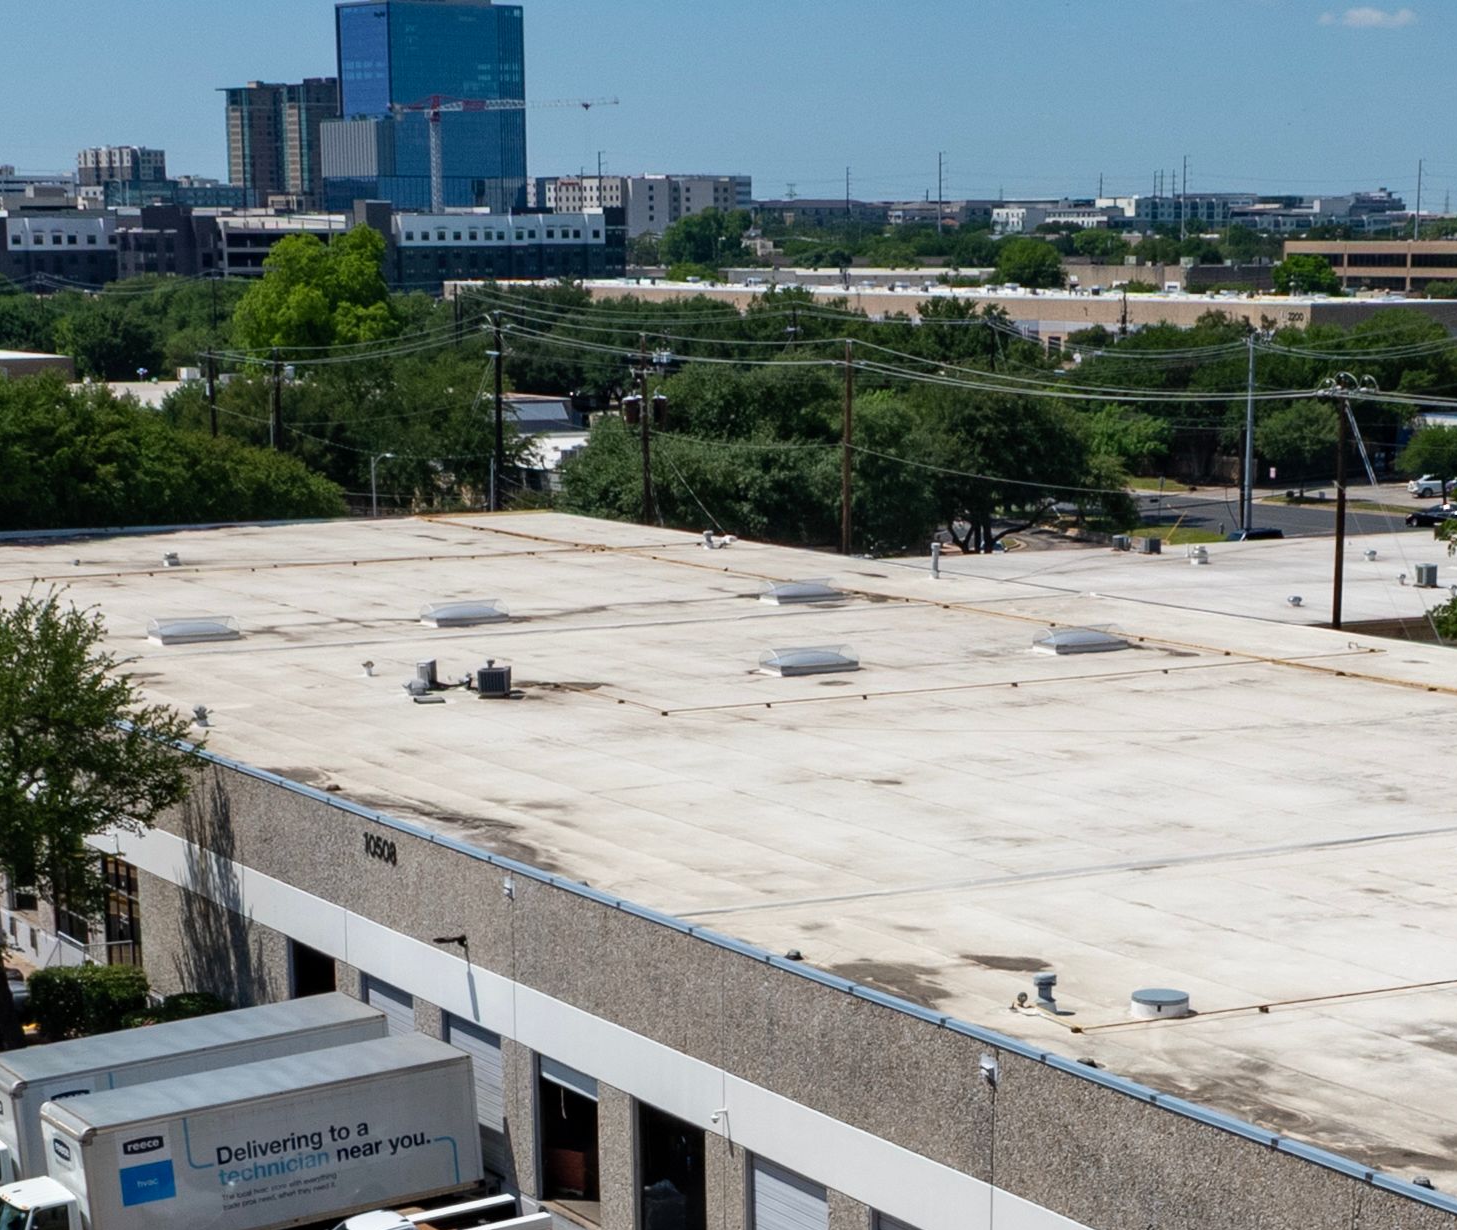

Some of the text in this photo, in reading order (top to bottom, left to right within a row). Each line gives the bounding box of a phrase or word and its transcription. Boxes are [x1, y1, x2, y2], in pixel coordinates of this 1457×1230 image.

[127, 1139, 159, 1152] reece
[216, 1122, 369, 1166] Delivering to a
[218, 1132, 431, 1186] technician near you.
